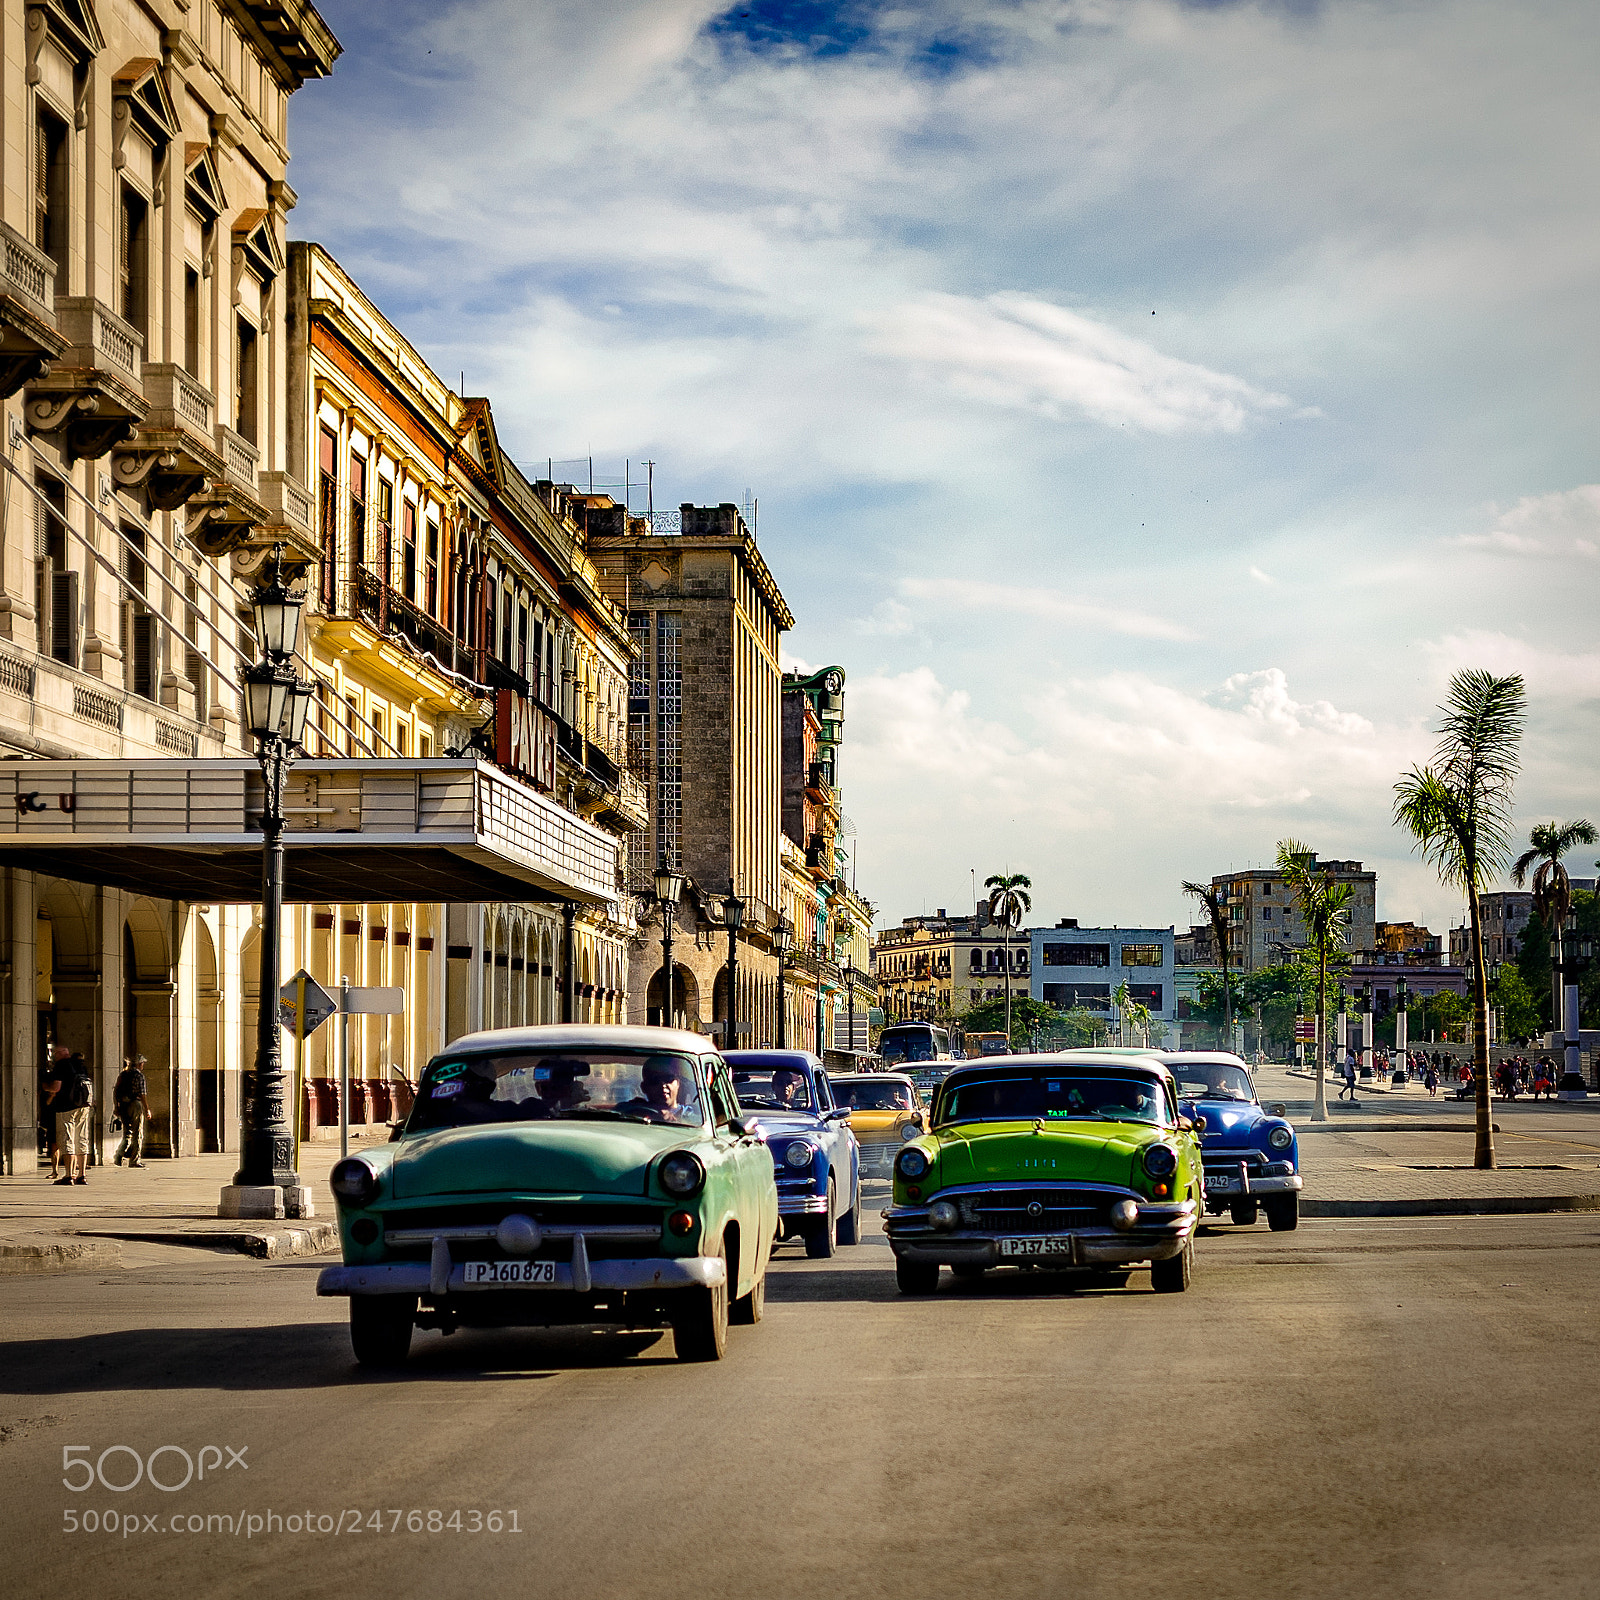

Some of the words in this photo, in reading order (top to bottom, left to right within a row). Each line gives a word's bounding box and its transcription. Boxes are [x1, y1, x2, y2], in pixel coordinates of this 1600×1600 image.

[59, 792, 76, 814] U
[433, 1064, 463, 1080] TAXI
[1047, 1109, 1068, 1117] TAXI
